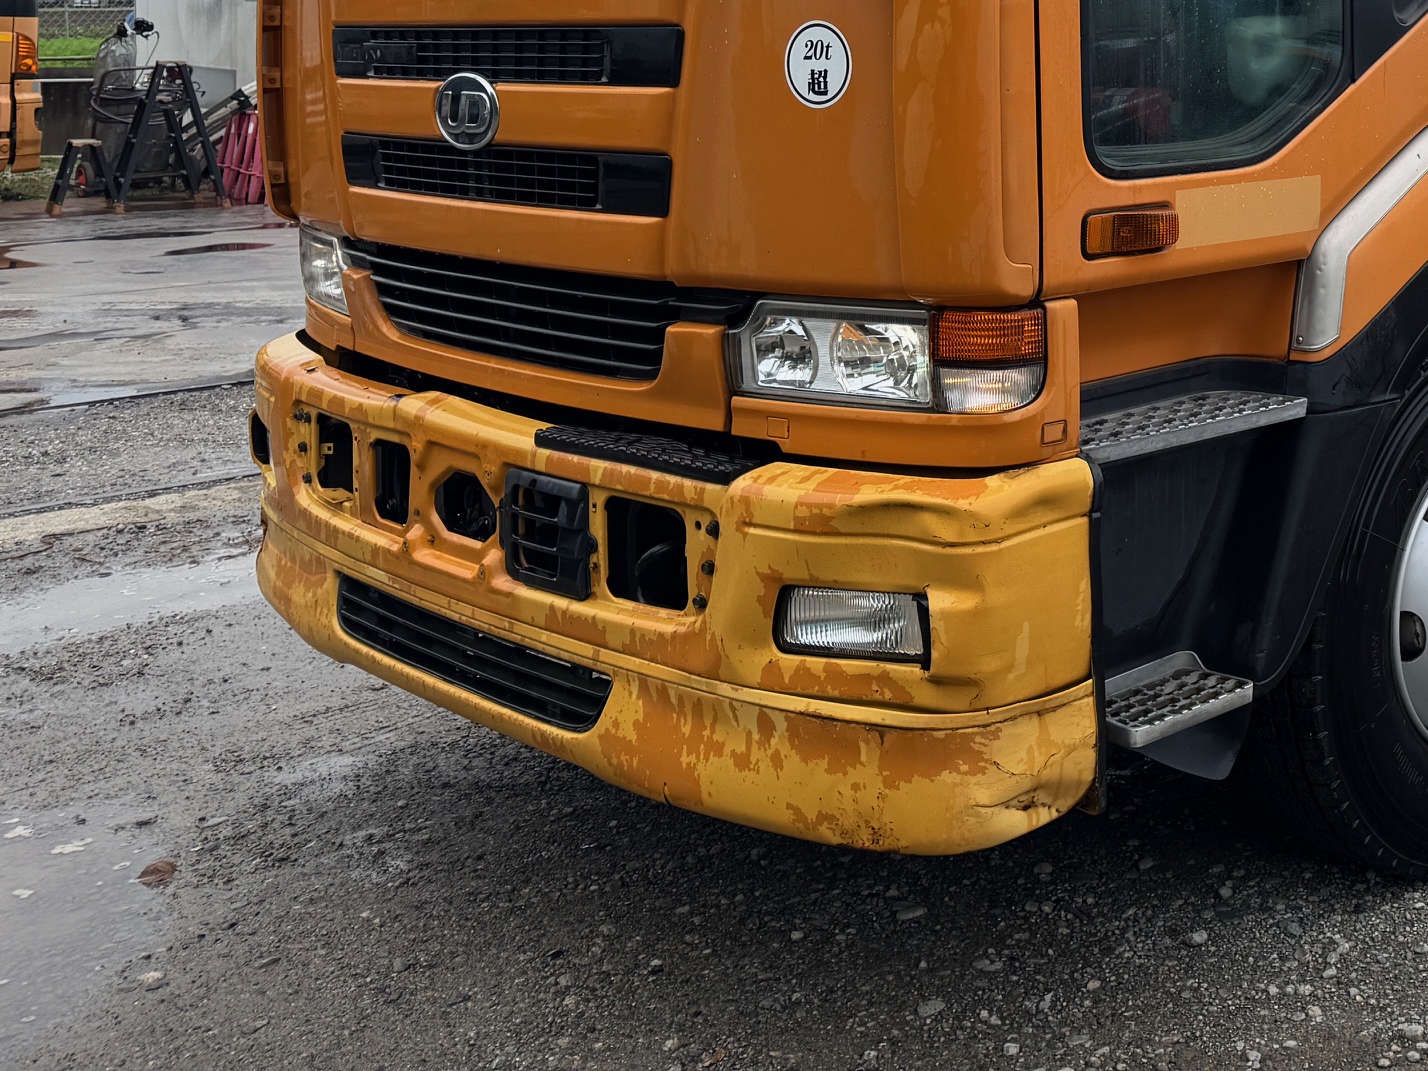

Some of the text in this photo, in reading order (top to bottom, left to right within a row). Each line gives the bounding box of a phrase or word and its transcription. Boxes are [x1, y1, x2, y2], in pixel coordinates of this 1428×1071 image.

[803, 39, 833, 61] 20t
[807, 68, 829, 96] 超
[440, 90, 491, 134] UD
